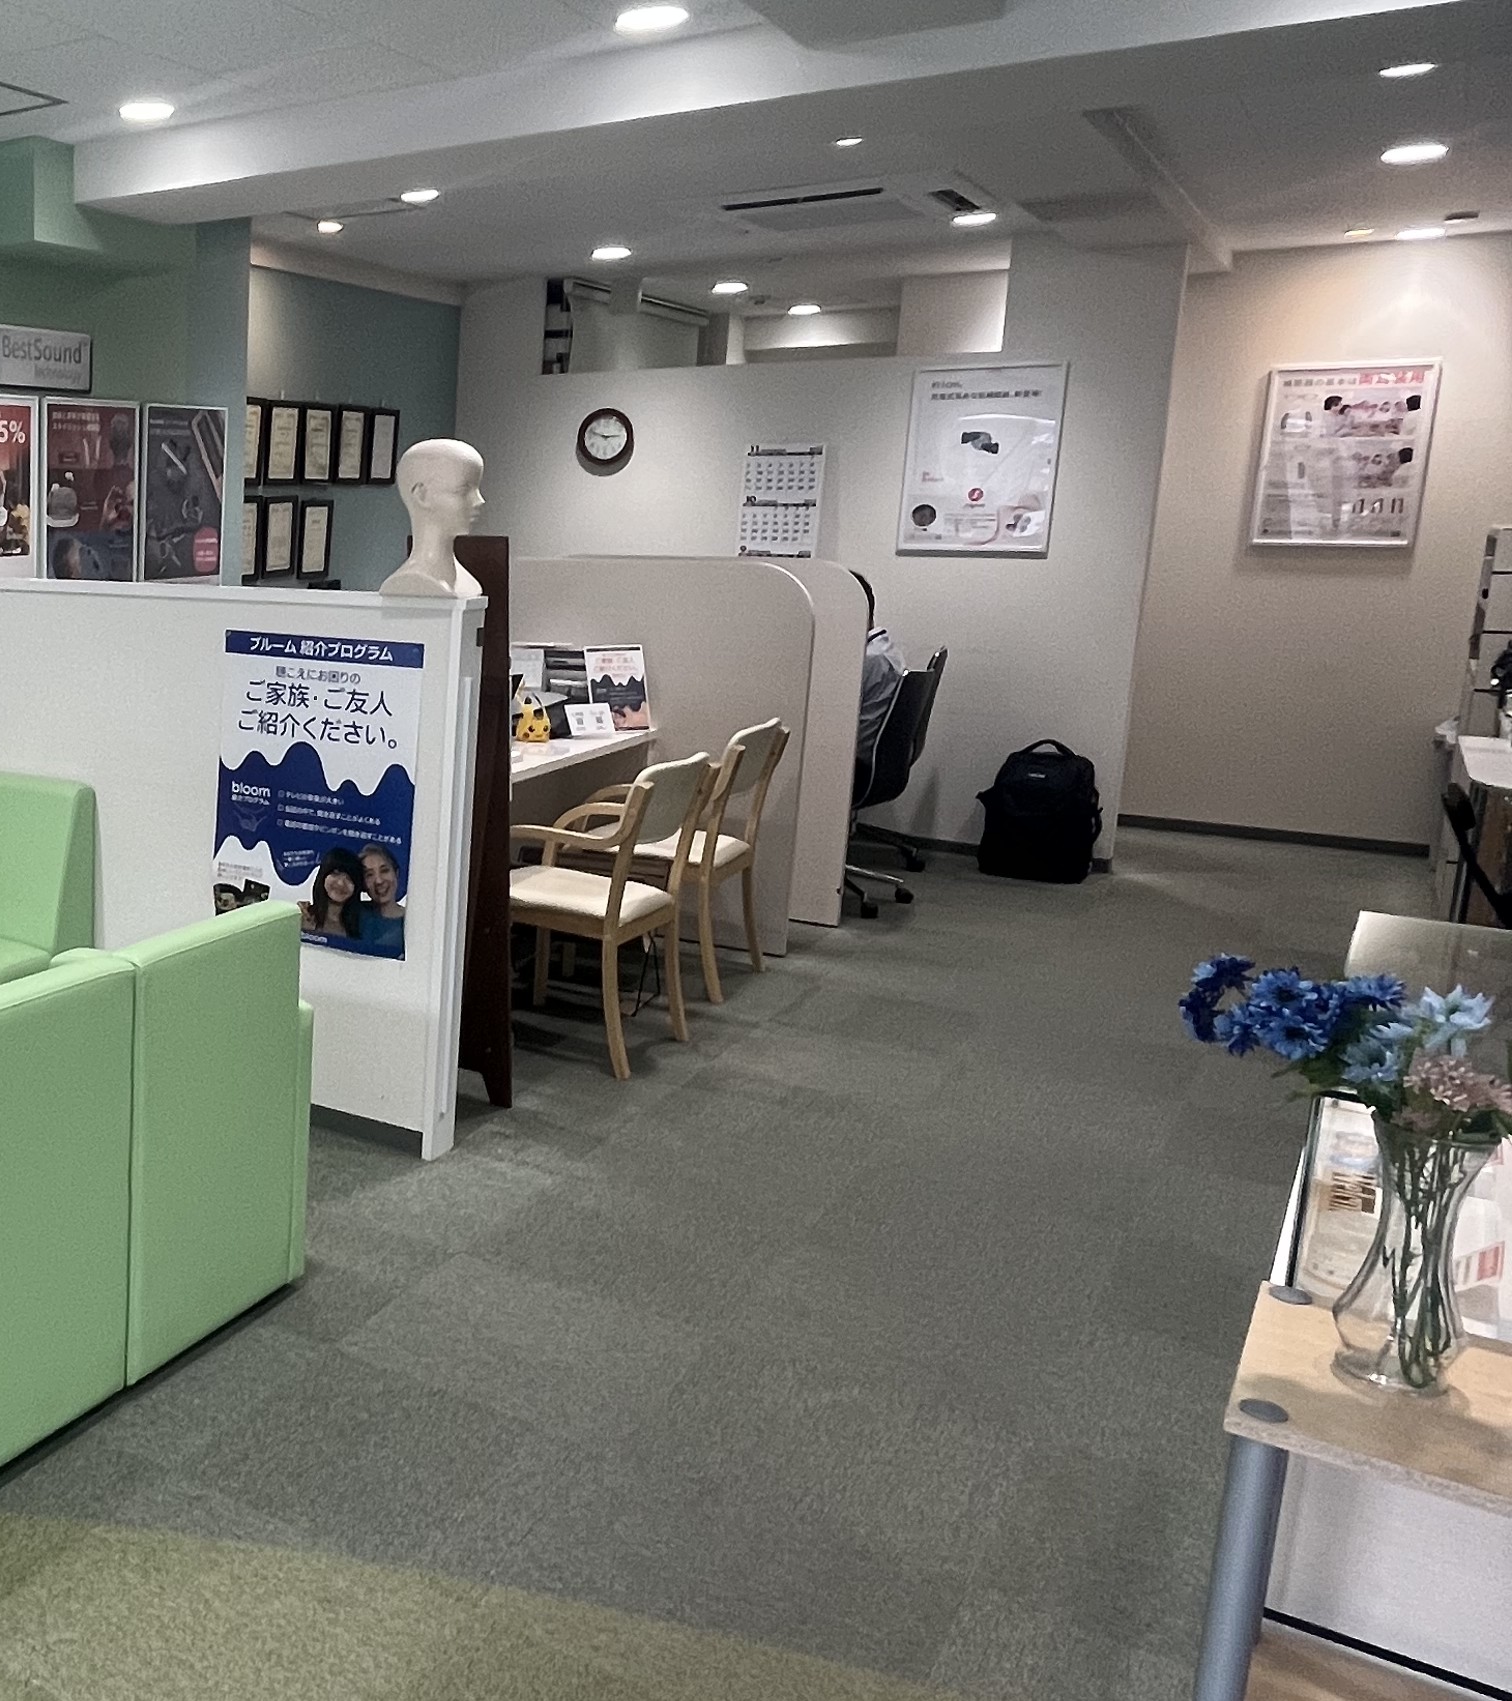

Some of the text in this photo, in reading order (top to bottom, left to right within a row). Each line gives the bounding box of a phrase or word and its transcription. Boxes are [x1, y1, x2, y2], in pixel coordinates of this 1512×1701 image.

[2, 335, 82, 364] BestSound
[250, 636, 393, 662] ブルーム 紹介プログラム
[246, 679, 393, 717] ご家族・ご友人
[238, 708, 398, 749] ご紹介ください。
[231, 780, 272, 798] bloom
